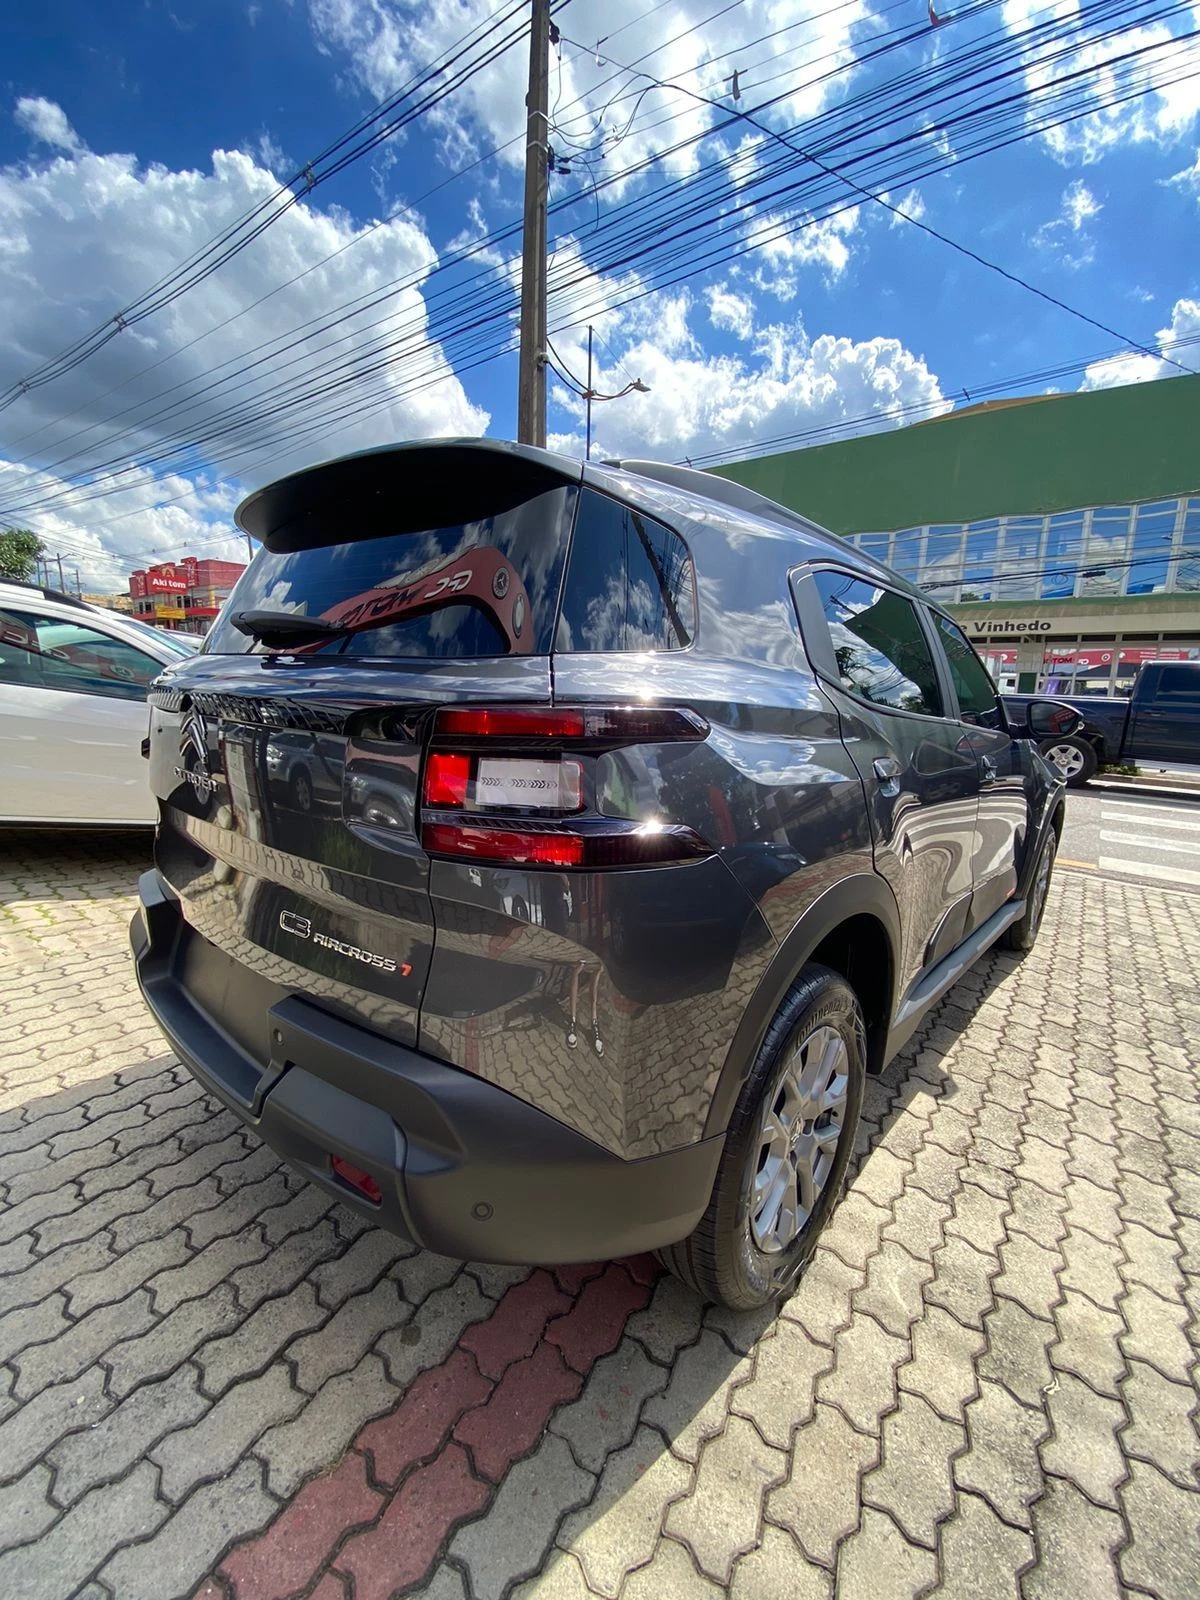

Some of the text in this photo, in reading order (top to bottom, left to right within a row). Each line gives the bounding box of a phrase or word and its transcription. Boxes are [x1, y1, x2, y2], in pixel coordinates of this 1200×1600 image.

[152, 578, 167, 586] Aki
[169, 580, 186, 589] tom
[974, 620, 1052, 633] Vinhedo
[279, 910, 311, 939] C3
[313, 932, 397, 972] AIRCROSS
